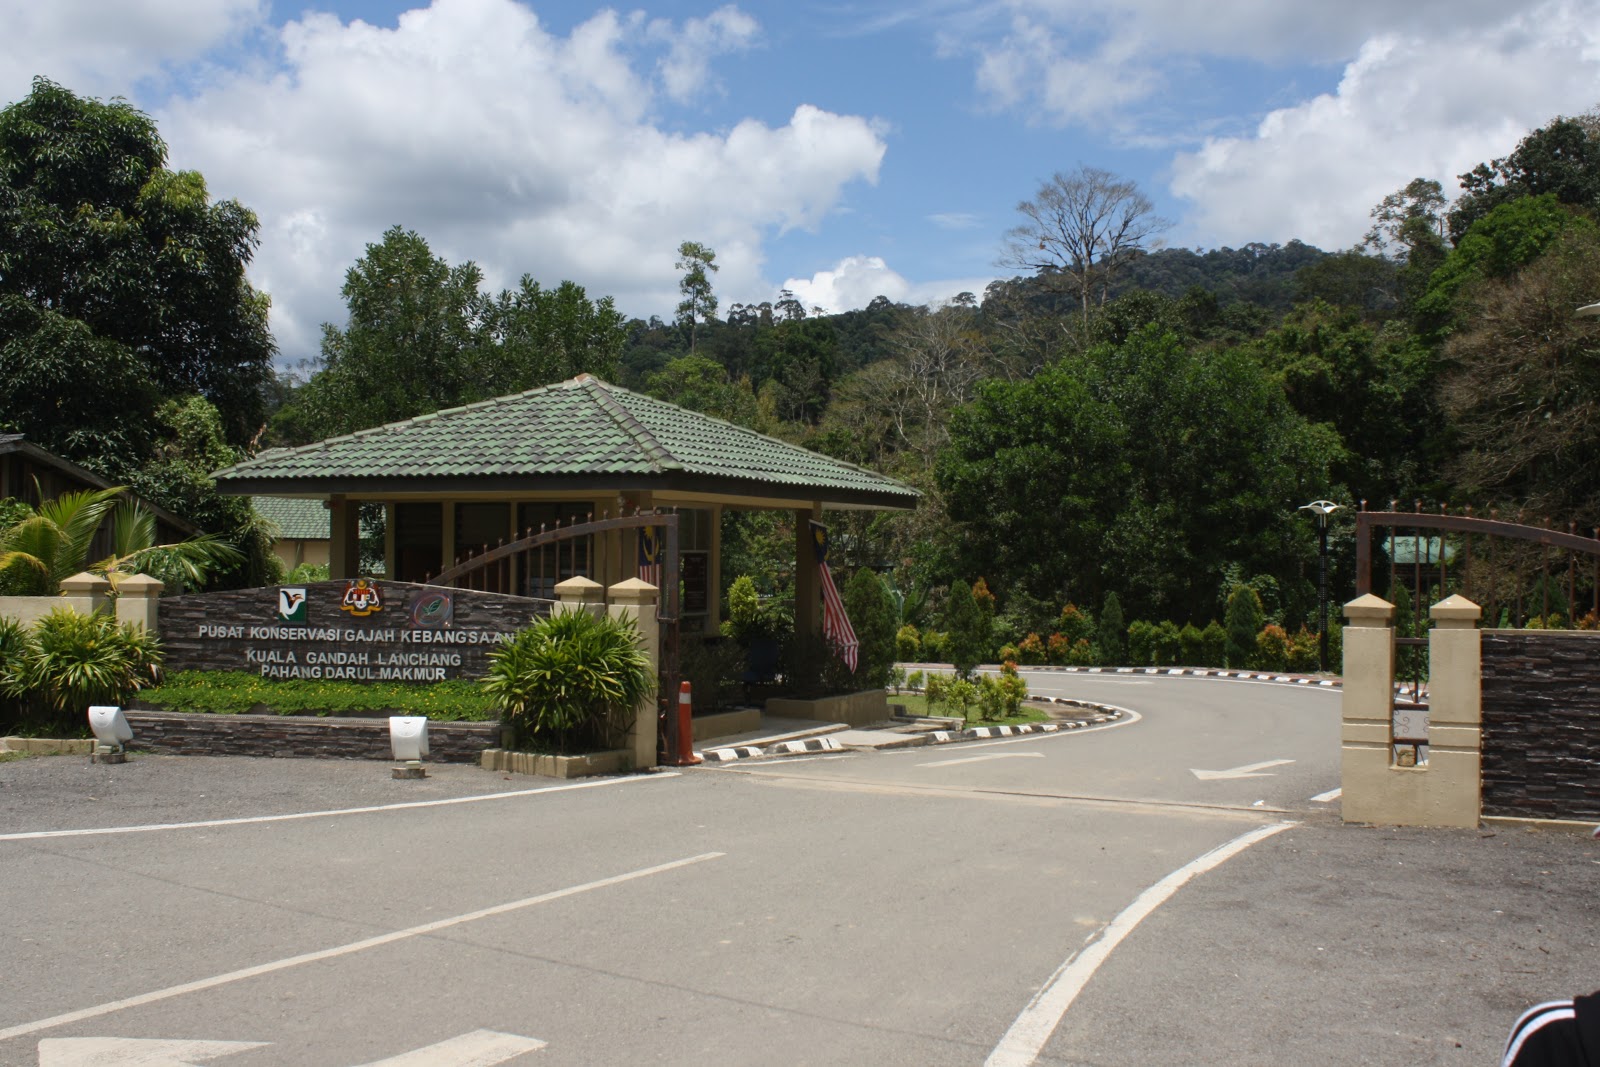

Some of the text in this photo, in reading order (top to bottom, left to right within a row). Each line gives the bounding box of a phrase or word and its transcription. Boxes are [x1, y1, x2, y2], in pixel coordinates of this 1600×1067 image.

[199, 625, 515, 644] PUSAT KONSERVASI GAJAH KEBANGSAAN
[247, 650, 461, 667] KUALA GANDAH LANCHANG
[261, 665, 446, 680] PAHANG DARUL MAKMUR
